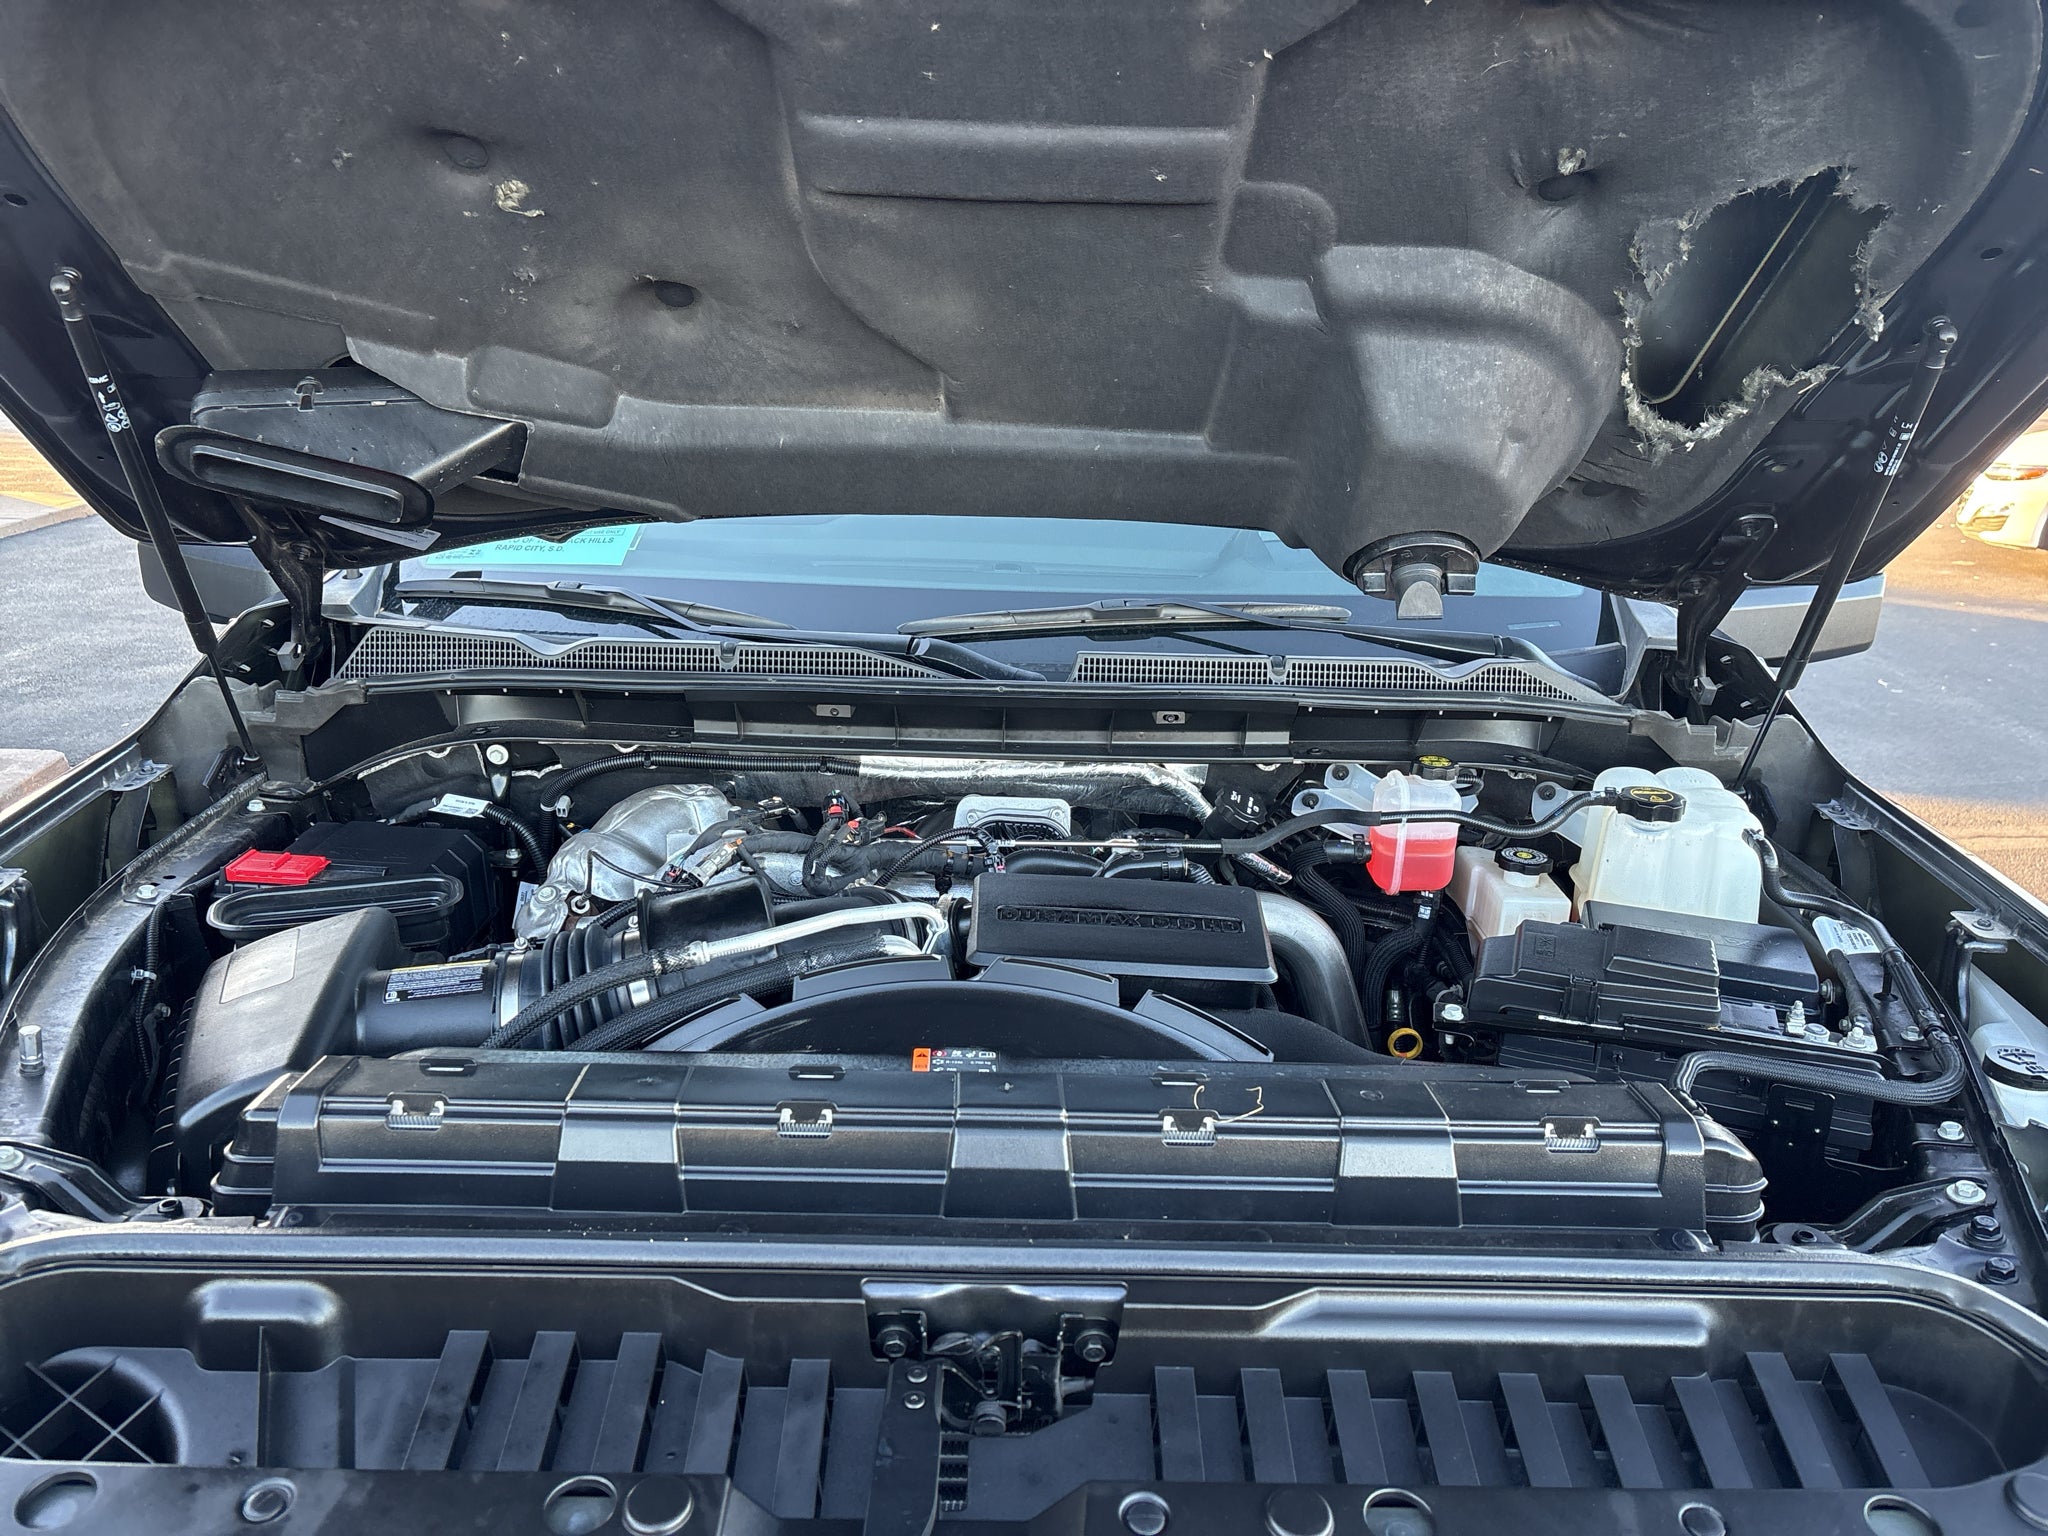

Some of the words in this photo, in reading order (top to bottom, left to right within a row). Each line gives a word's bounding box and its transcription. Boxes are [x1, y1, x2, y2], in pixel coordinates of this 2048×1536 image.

[88, 374, 110, 384] GMC
[1901, 421, 1913, 429] LH
[1000, 908, 1142, 927] DURAMAX
